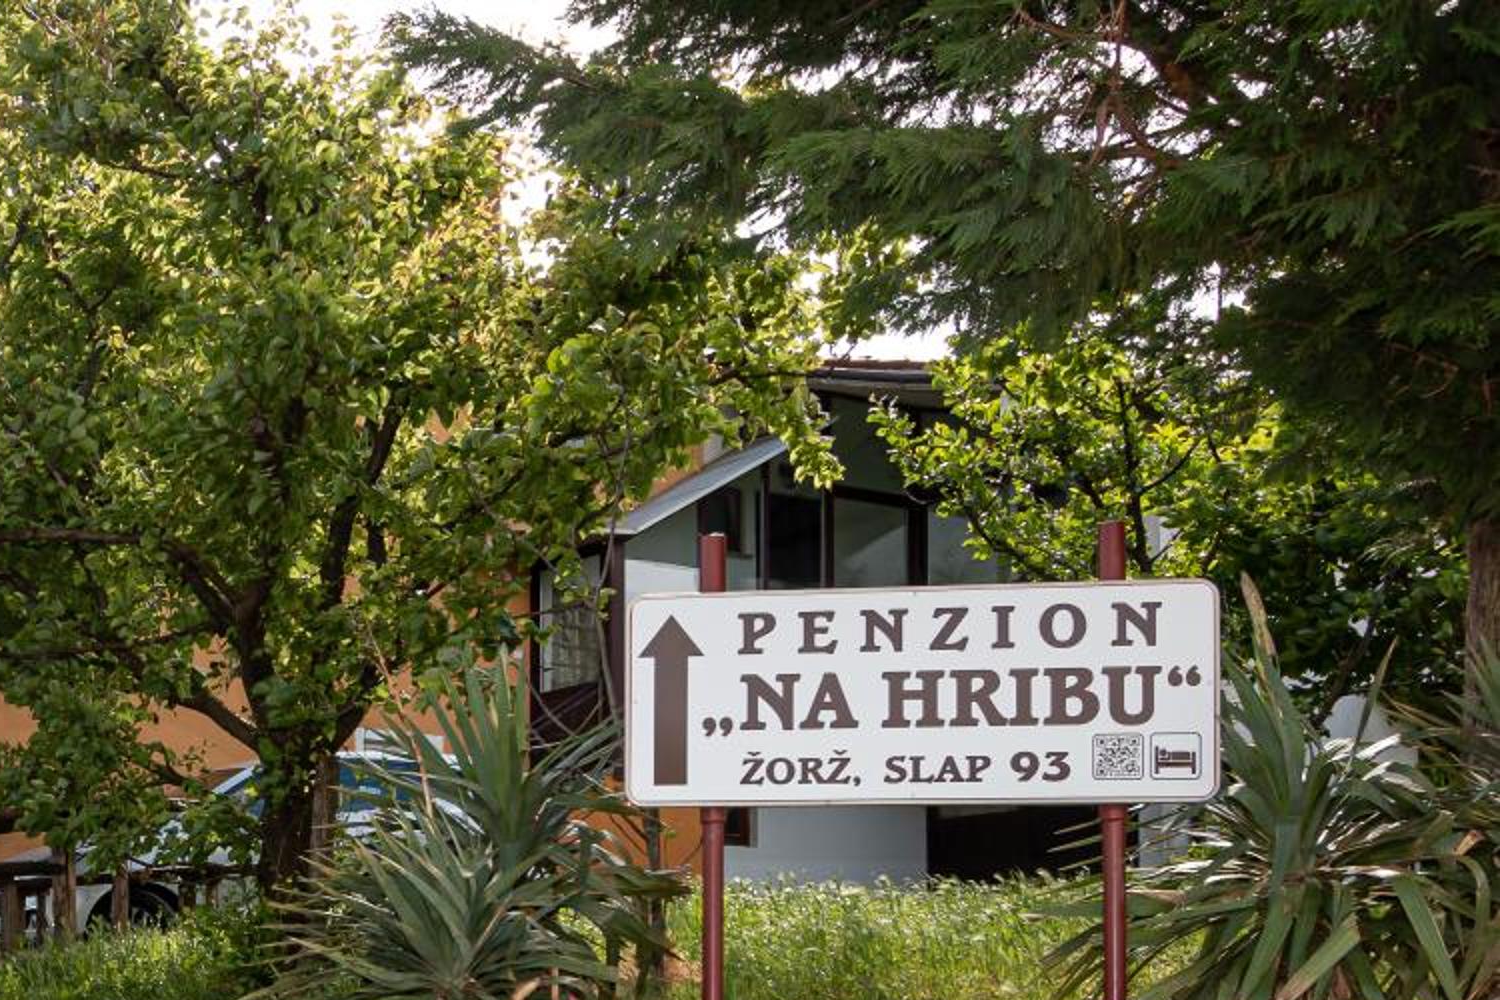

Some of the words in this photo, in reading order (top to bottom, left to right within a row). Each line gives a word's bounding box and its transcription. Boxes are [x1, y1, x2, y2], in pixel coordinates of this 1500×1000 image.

[737, 601, 1163, 655] PENZION
[739, 749, 861, 787] ŽORŽ,
[883, 755, 992, 784] SLAP
[1009, 751, 1071, 783] 93
